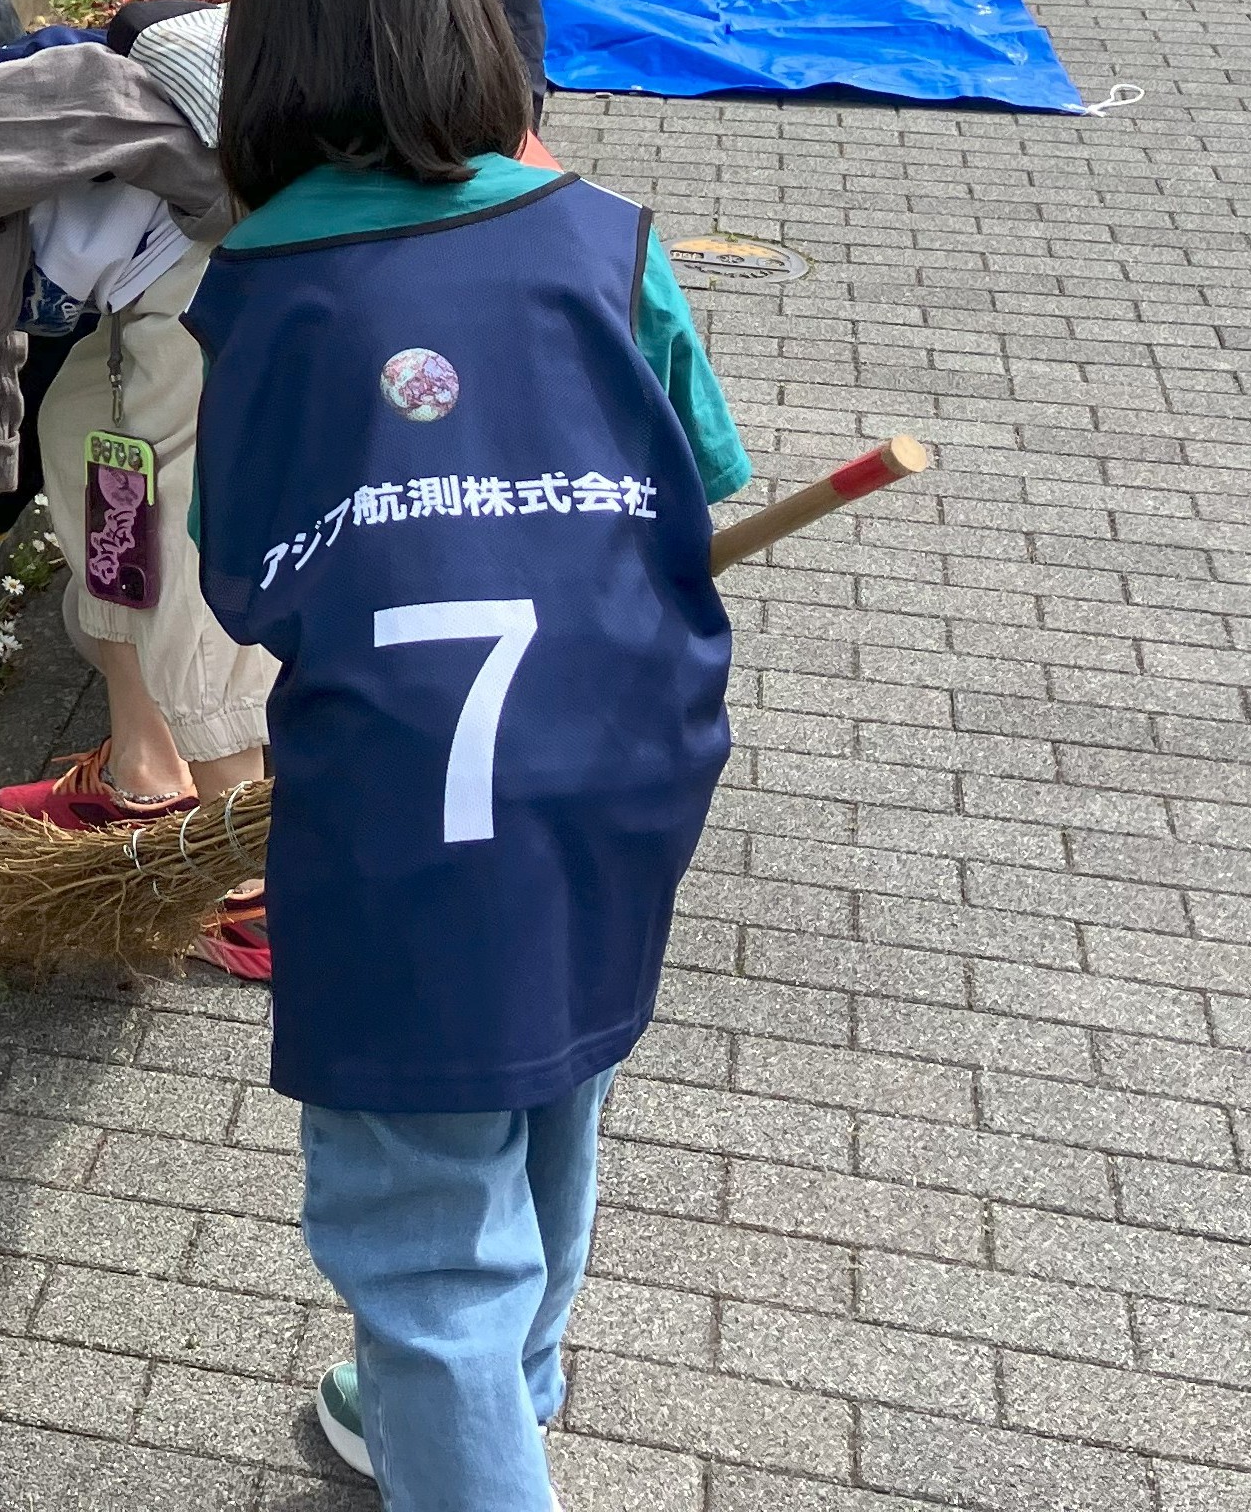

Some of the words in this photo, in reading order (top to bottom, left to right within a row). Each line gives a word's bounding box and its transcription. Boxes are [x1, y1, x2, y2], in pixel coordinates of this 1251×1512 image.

[260, 471, 657, 590] アジア航測株式会社
[373, 598, 538, 844] 7
